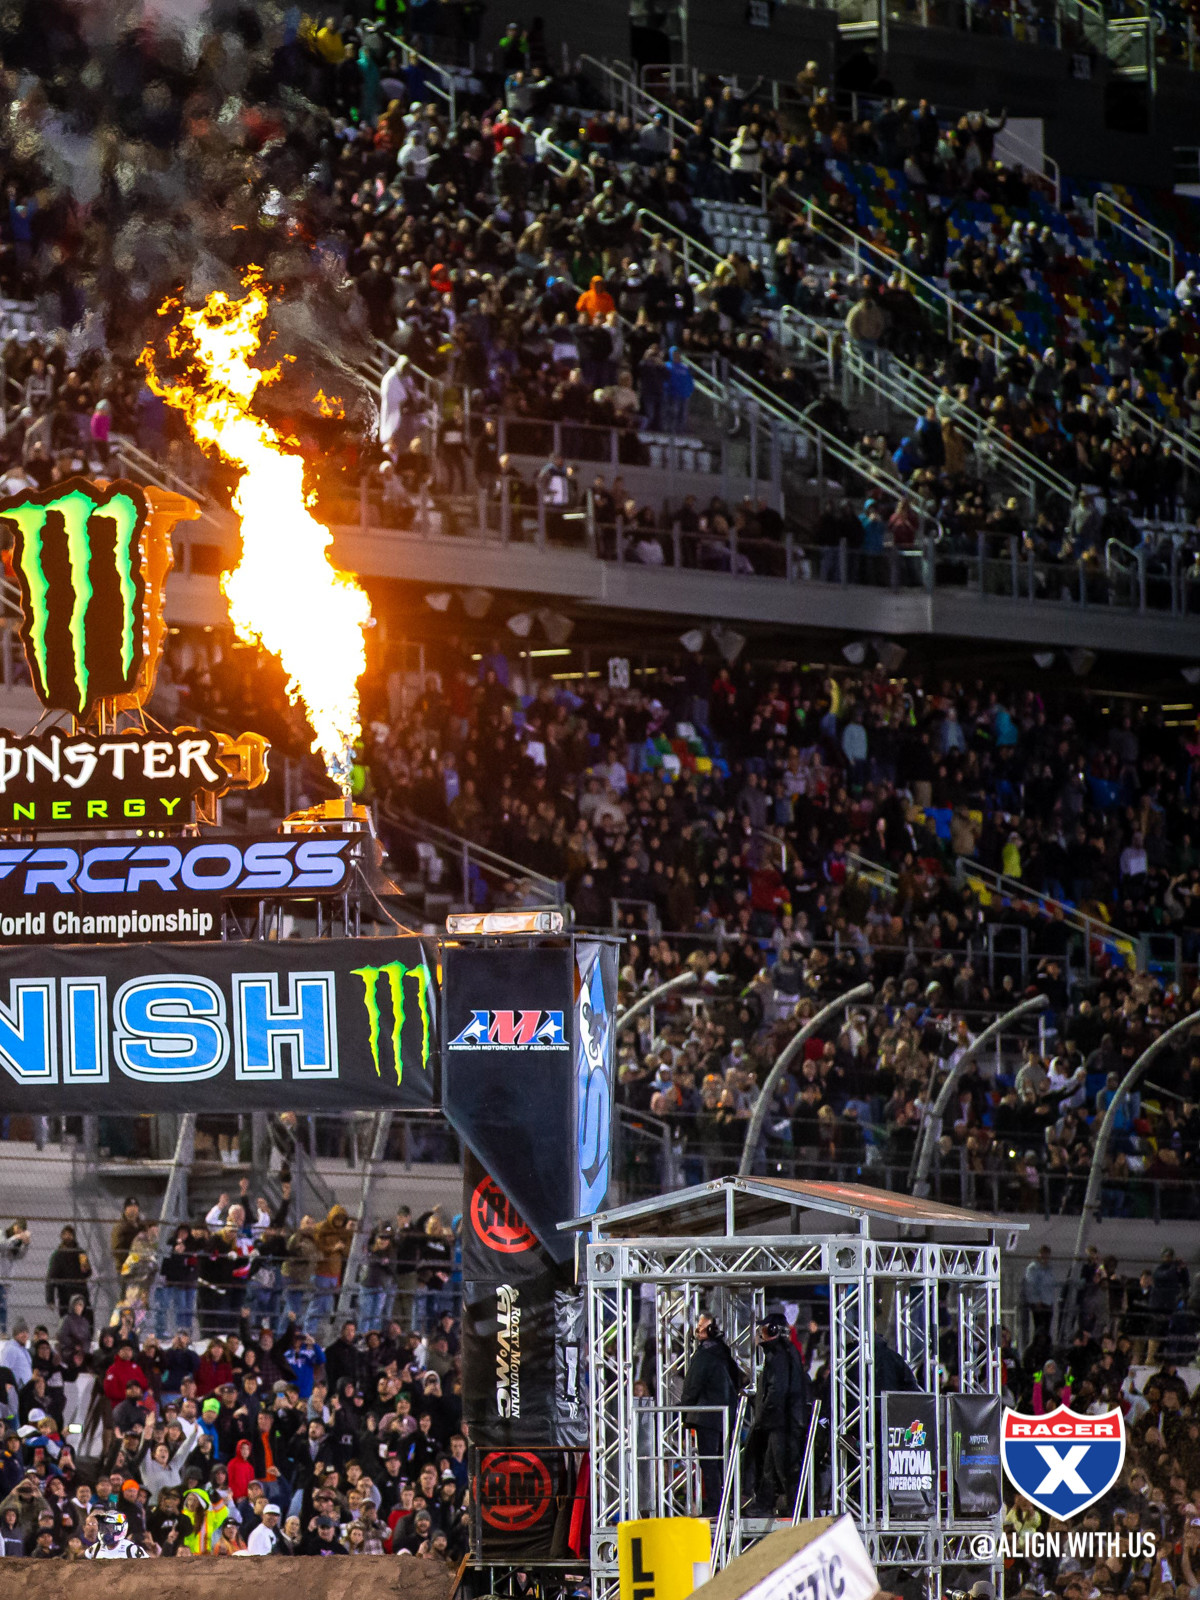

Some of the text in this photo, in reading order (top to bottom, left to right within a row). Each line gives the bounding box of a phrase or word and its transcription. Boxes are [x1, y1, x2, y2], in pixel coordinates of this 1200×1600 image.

[53, 908, 214, 937] Championship
[447, 1010, 571, 1045] AMA
[511, 1305, 521, 1419] ROCKY MOUNTAIN
[888, 1450, 932, 1475] DAYTONA
